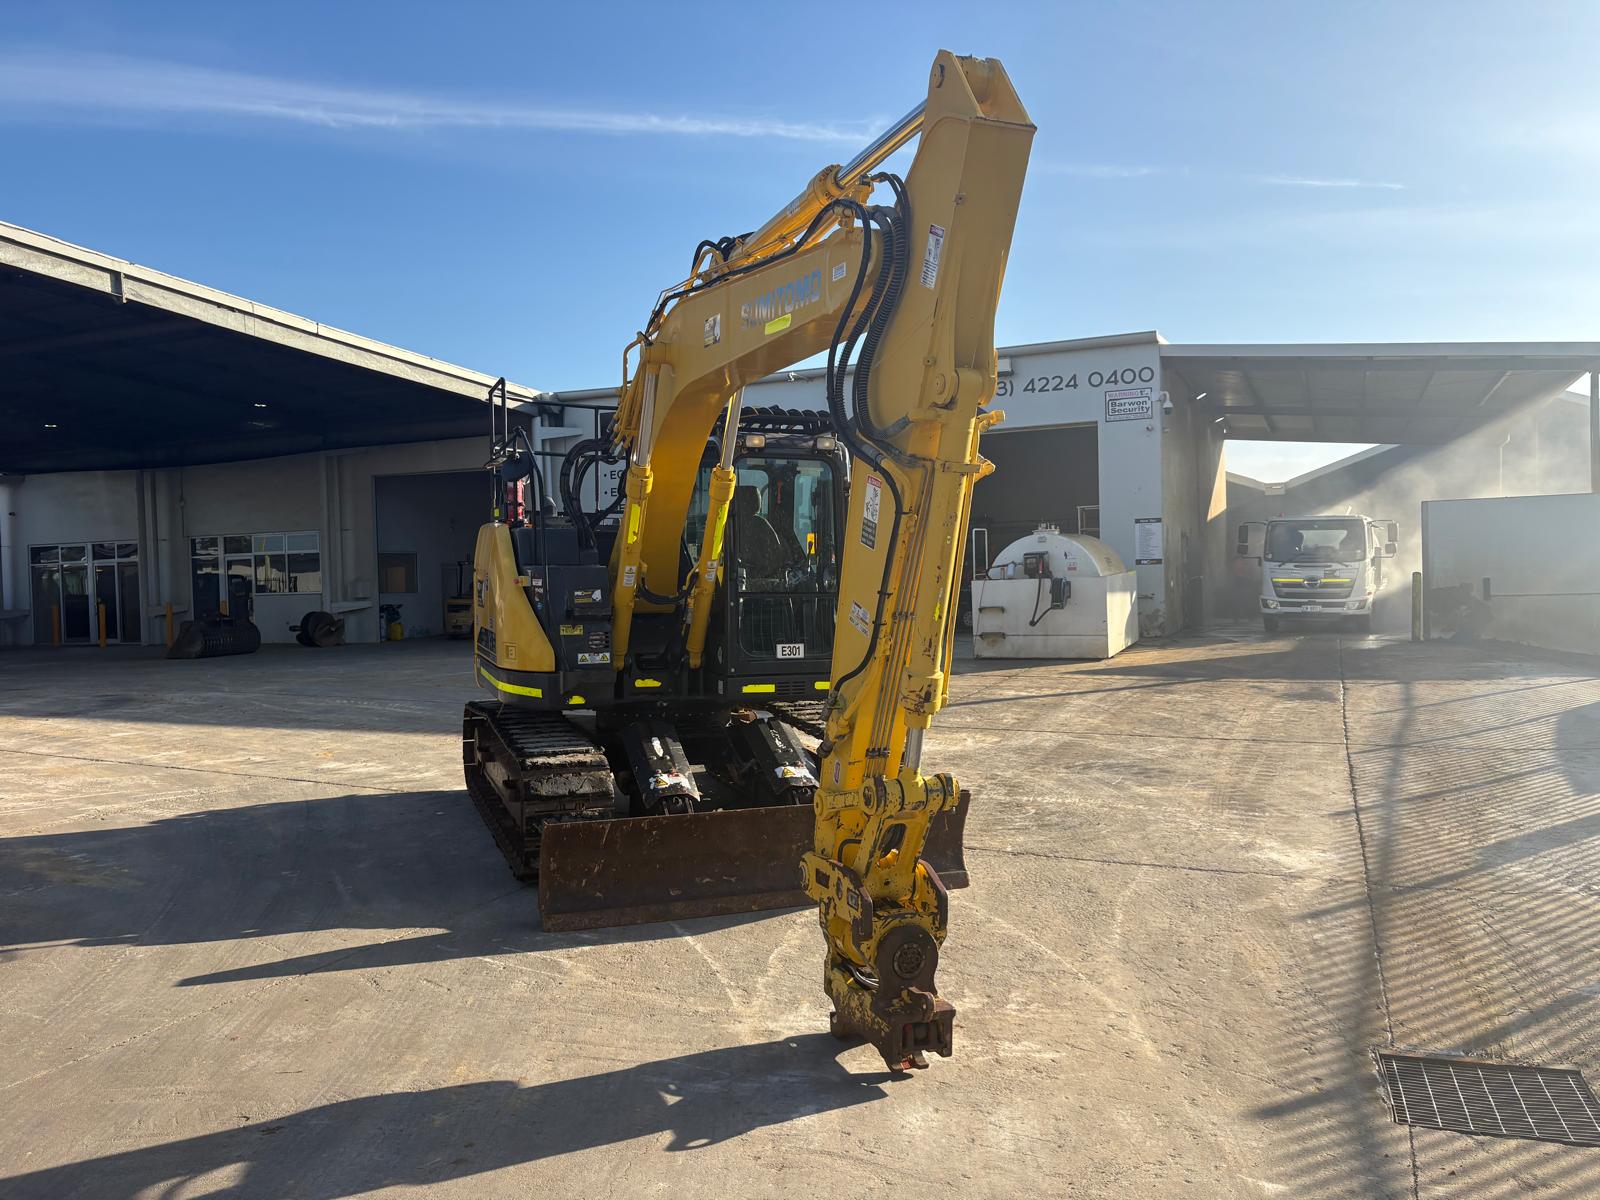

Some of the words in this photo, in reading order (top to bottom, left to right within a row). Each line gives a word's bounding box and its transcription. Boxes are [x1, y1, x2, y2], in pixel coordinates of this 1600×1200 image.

[741, 271, 822, 320] SUMITOMO
[1023, 374, 1079, 393] 4224
[1088, 367, 1155, 387] 0400
[1110, 400, 1148, 408] Barwon
[1110, 405, 1151, 414] Security
[781, 645, 801, 657] E301
